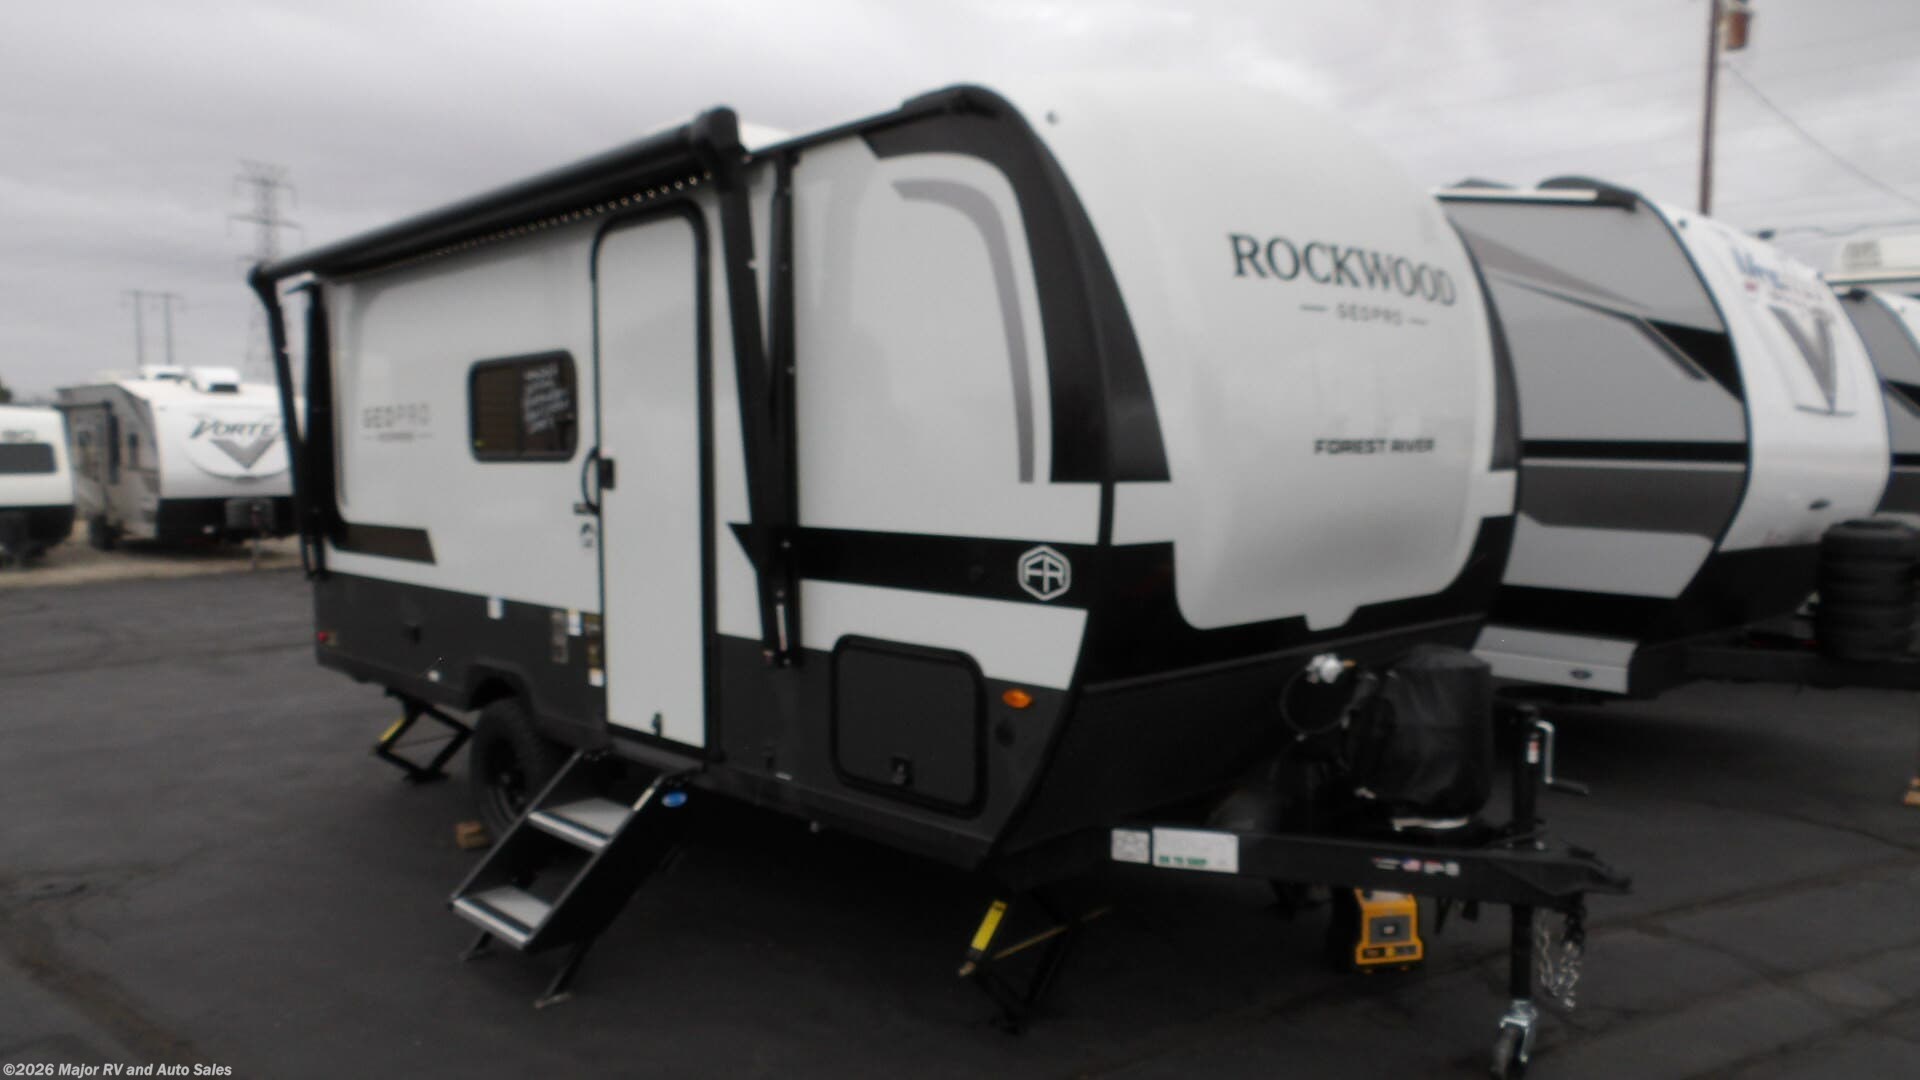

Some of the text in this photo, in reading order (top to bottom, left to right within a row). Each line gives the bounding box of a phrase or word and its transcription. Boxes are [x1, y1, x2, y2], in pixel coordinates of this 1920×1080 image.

[1228, 232, 1457, 307] ROCKWOOD
[1313, 437, 1436, 456] FOREST RIVER
